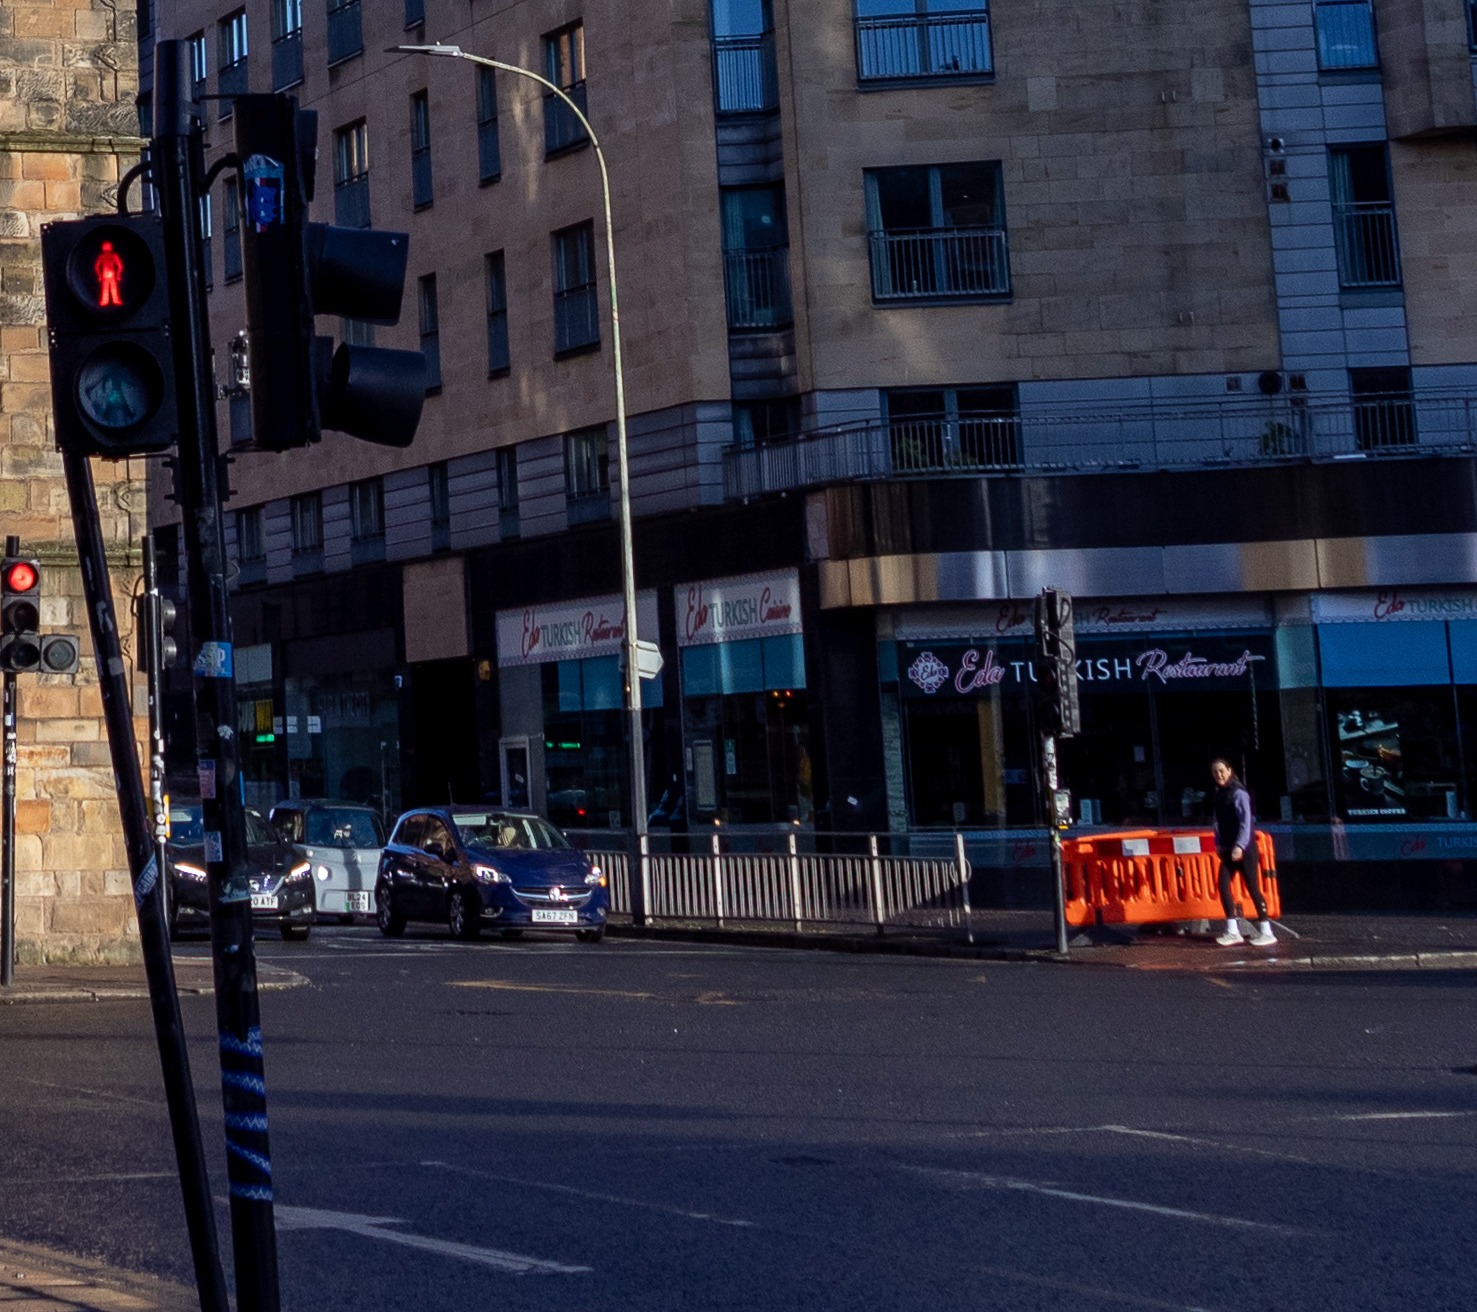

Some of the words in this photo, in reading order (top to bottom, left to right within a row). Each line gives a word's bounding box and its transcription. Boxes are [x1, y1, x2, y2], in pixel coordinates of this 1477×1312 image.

[709, 598, 758, 629] TURKISH
[1407, 599, 1473, 613] TURKISH
[540, 621, 581, 645] TURKISH
[955, 648, 1005, 694] Eda
[1135, 648, 1266, 685] Restaurant
